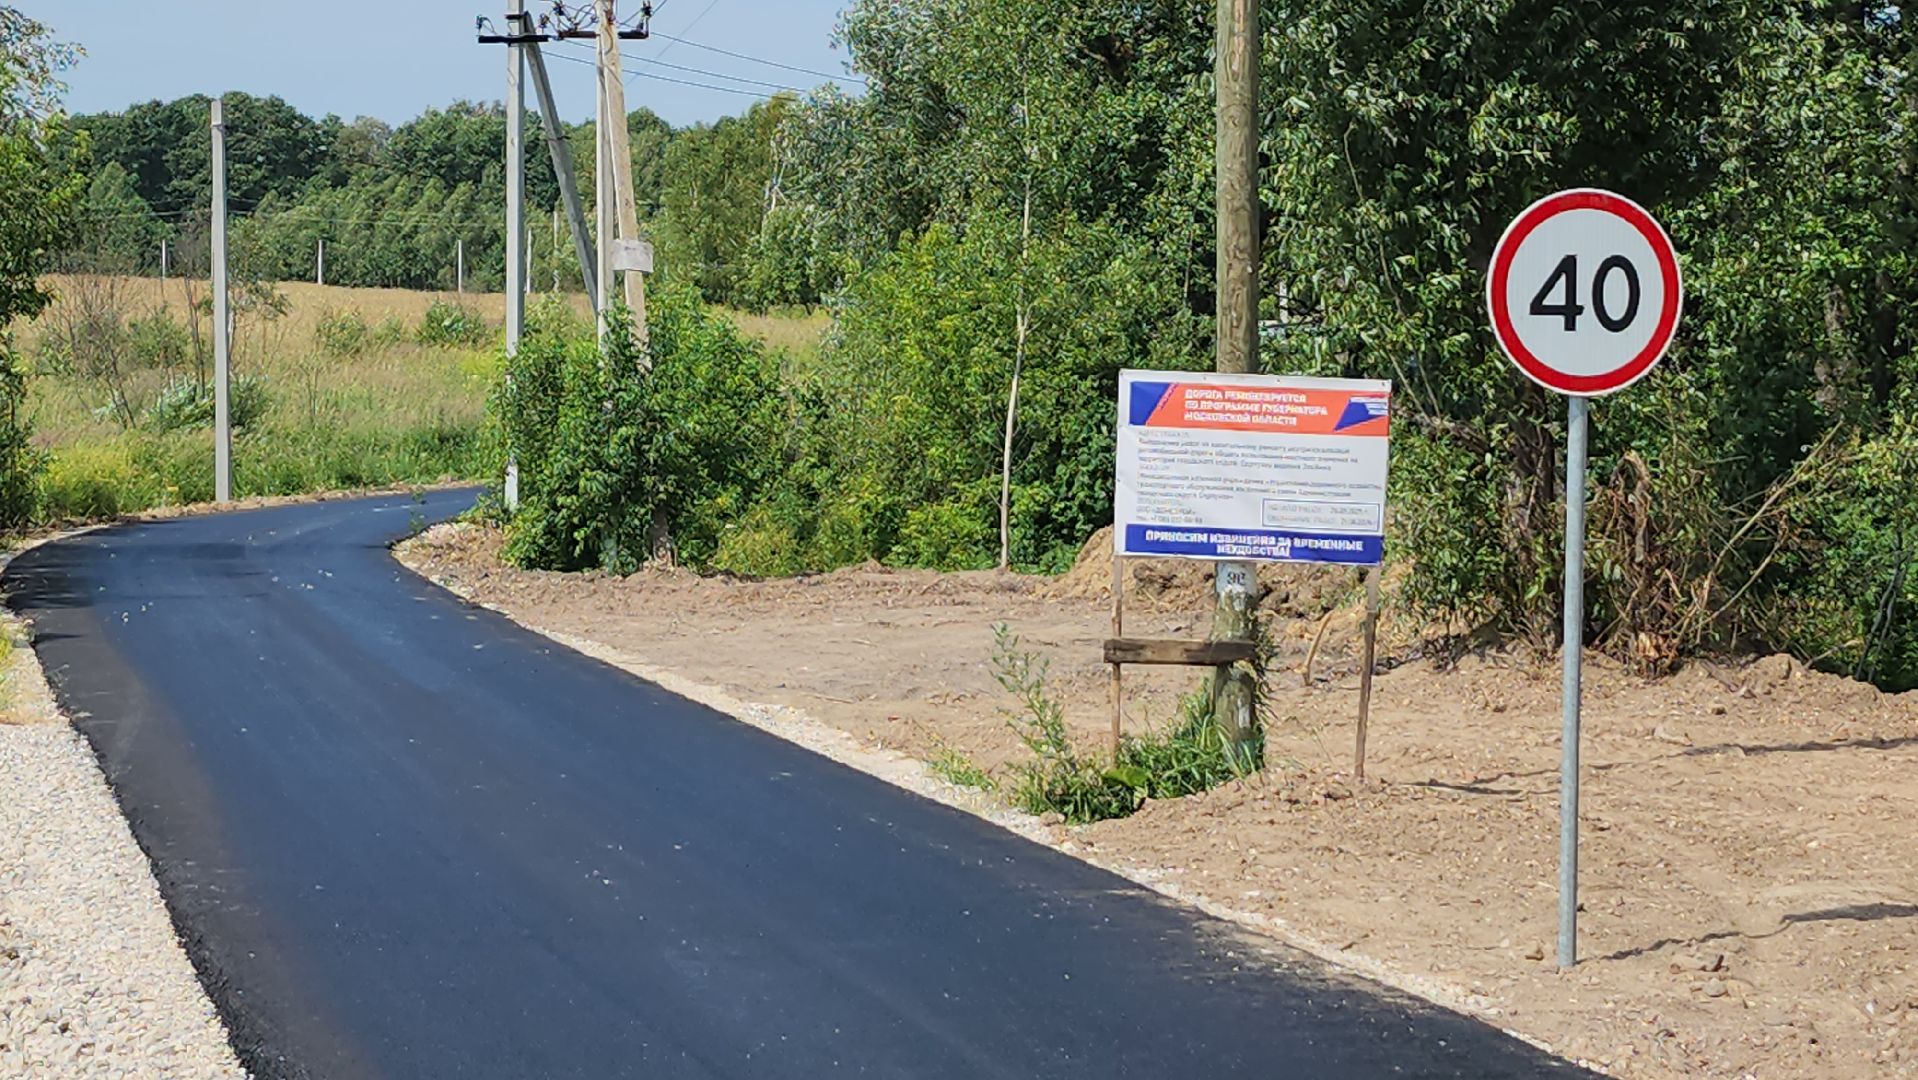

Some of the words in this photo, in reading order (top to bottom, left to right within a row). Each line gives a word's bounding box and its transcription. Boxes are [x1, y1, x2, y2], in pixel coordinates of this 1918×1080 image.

[1529, 254, 1640, 333] 40
[1185, 389, 1223, 399] ДОРОГА
[1185, 400, 1198, 409] ПО
[1201, 401, 1261, 412] ПРОГРАММЕ
[1262, 403, 1328, 416] ГУБЕРНАТОРА
[1184, 411, 1250, 423] МОСКОВСКОЙ
[1252, 415, 1297, 426] ОБЛАСТИ
[1145, 530, 1208, 543] ПРИНОСИМ
[1210, 533, 1276, 546] ИЗВИНЕНИЯ
[1277, 536, 1291, 547] ЗА
[1294, 537, 1363, 551] ВРЕМЕННЫЕ
